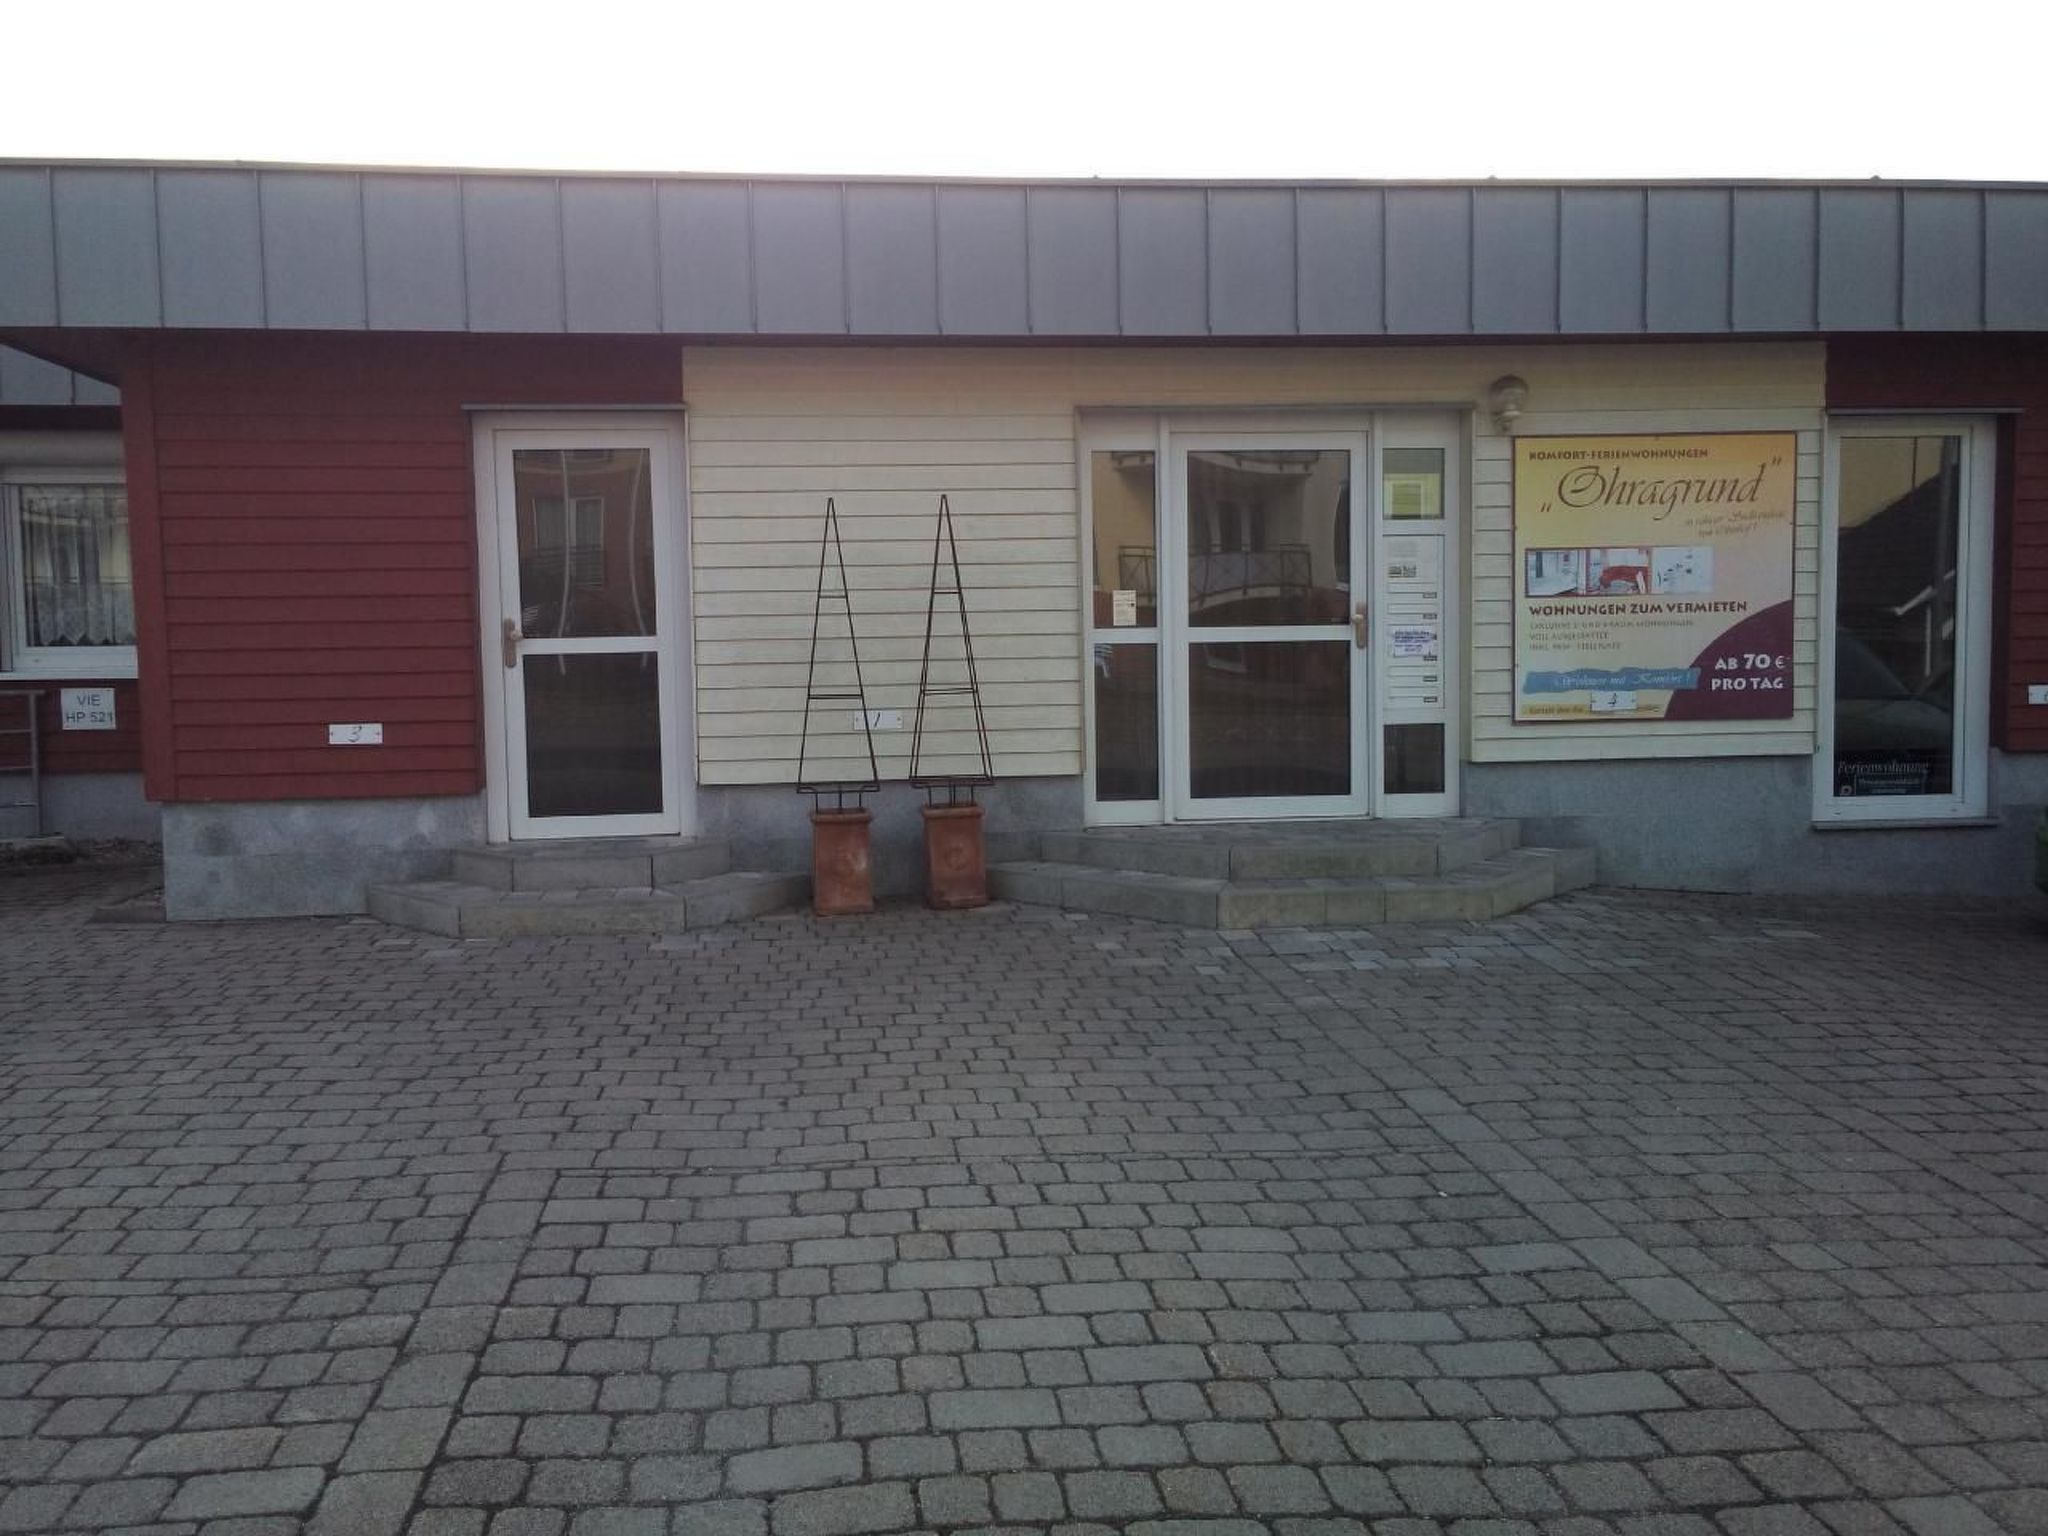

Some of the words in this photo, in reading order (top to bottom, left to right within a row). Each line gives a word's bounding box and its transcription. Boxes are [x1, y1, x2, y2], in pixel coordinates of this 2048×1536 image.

[1529, 449, 1708, 461] KOMFORT-FERIENWOHNUNGEN
[1529, 604, 1626, 616] WOHNUNGEN
[1630, 603, 1662, 614] ZUM
[1666, 601, 1747, 614] VERMIETEN
[1715, 656, 1739, 670] AB
[1743, 653, 1771, 670] 70
[1775, 655, 1785, 669] €
[1711, 678, 1747, 691] PRO
[1750, 677, 1784, 690] TAG
[76, 694, 101, 706] VIE
[66, 711, 86, 723] HP
[90, 711, 113, 723] 521
[348, 725, 362, 743] 3
